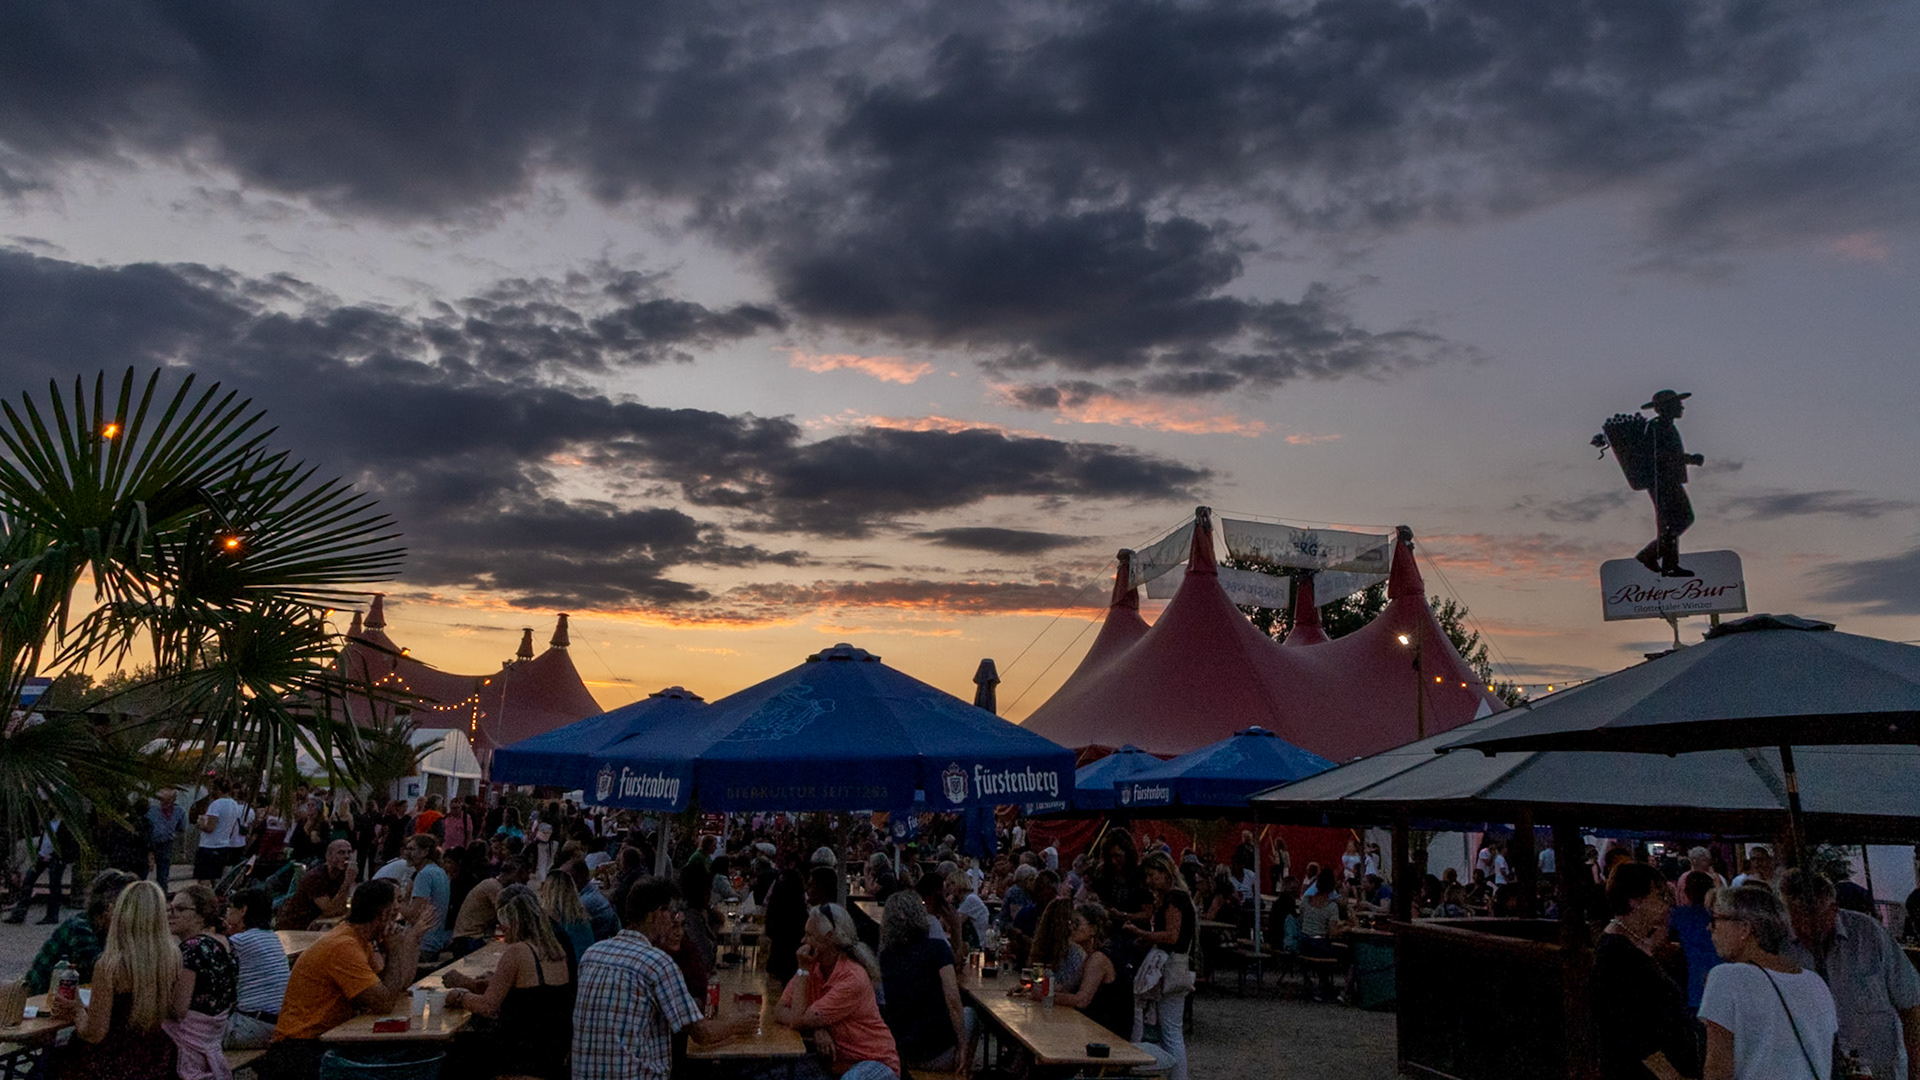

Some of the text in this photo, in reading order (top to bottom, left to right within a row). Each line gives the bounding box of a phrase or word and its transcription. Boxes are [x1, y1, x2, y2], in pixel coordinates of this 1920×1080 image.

[1608, 579, 1738, 604] Roter Bur
[1683, 601, 1712, 609] Winzer
